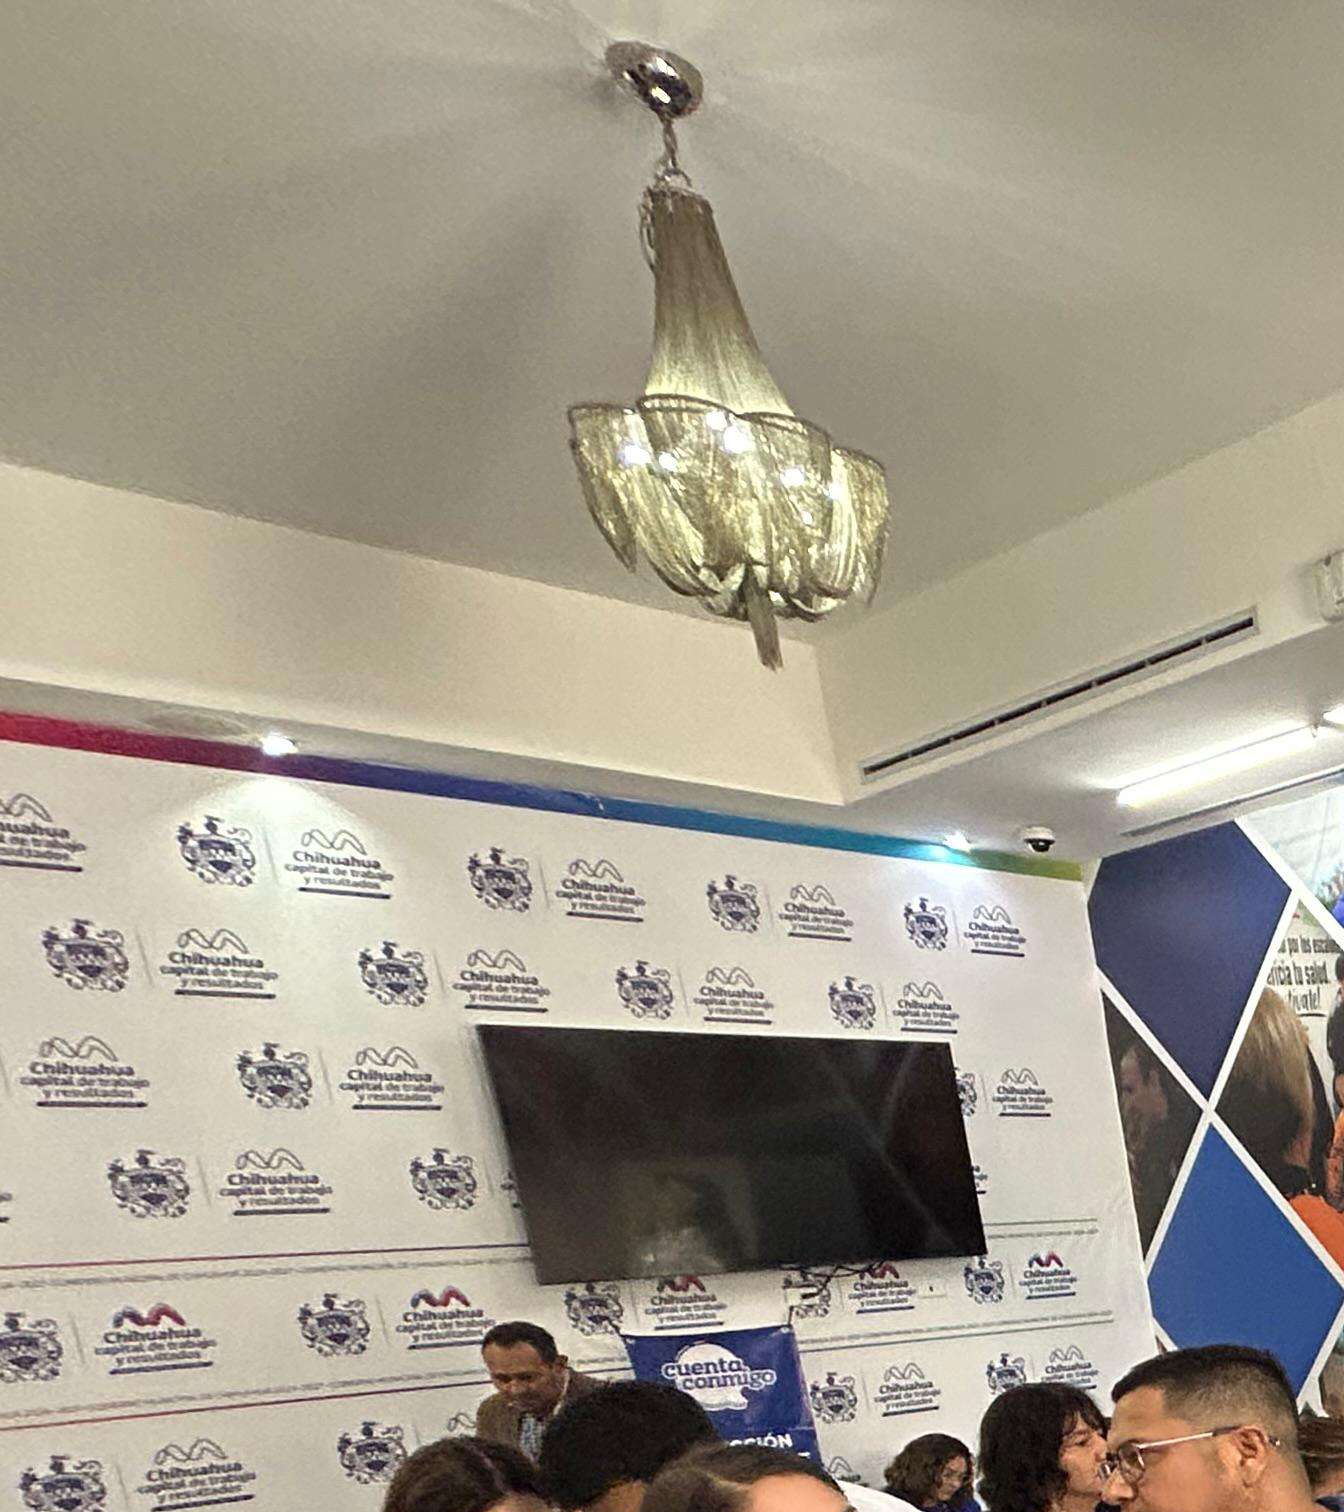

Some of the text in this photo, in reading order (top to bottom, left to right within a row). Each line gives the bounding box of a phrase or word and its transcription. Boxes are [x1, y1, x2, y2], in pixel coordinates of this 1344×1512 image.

[293, 851, 380, 869] Chihuahua
[285, 864, 394, 881] capital de trabajo
[314, 877, 380, 889] resultados
[562, 879, 635, 896] Chihuahua
[556, 890, 646, 907] capital de trabajo
[580, 902, 634, 914] resultados
[784, 902, 845, 918] Chihuahua
[969, 922, 1019, 935] Chihuahua
[169, 951, 263, 968] Chihuahua
[160, 965, 278, 981] capital de trabajo
[460, 970, 538, 986] Chihuahua
[192, 979, 263, 990] resultados
[452, 983, 550, 998] capital de trabajo
[479, 993, 538, 1004] resultados
[699, 985, 764, 1000] Chihuahua
[897, 999, 952, 1011] Chihuahua
[30, 1062, 134, 1076] Chihuahua
[347, 1069, 432, 1083] Chihuahua
[20, 1076, 149, 1090] capital de trabajo
[339, 1082, 445, 1094] capital de trabajo
[54, 1088, 135, 1099] resultados
[366, 1093, 432, 1102] resultados
[227, 1173, 319, 1185] Chihuahua
[220, 1185, 333, 1197] capital de trabajo
[247, 1196, 320, 1206] resultados
[1024, 1269, 1070, 1279] Chihuahua
[853, 1280, 908, 1292] Chihuahua
[651, 1293, 716, 1306] Chihuahua
[403, 1309, 483, 1322] Chihuahua
[396, 1318, 497, 1333] capital de trabajo
[103, 1328, 202, 1344] Chihuahua
[95, 1339, 216, 1357] capital de trabajo
[126, 1351, 202, 1363] resultados
[663, 1357, 743, 1377] cuenta
[683, 1372, 774, 1390] conmigo
[879, 1381, 933, 1394] Chihuahua
[147, 1462, 242, 1482] Chihuahua
[137, 1471, 256, 1495] capital de trabajo
[168, 1485, 242, 1500] resultados
